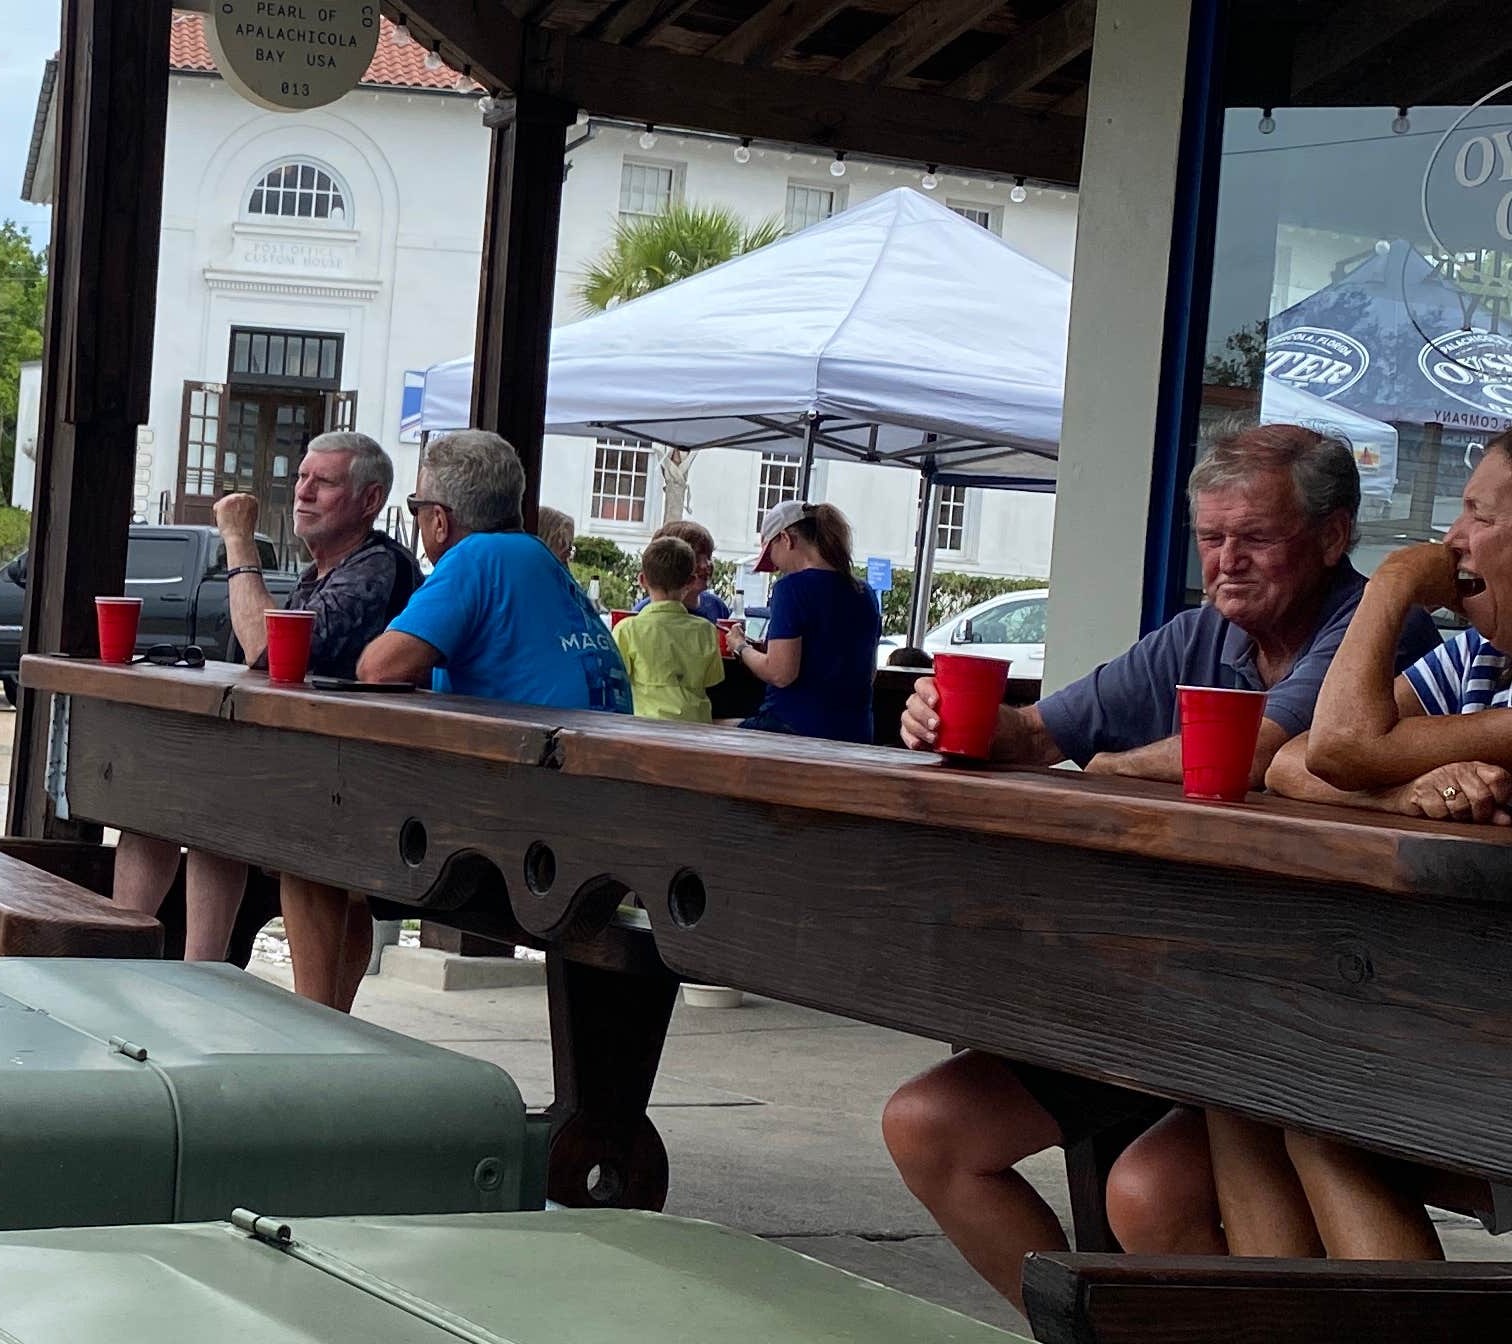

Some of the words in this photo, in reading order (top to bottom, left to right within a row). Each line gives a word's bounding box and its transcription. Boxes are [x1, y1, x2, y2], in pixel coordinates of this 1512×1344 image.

[256, 1, 307, 20] PEARL
[318, 8, 337, 22] OF
[361, 5, 373, 28] CO
[235, 23, 357, 47] APALACHICOLA
[255, 48, 286, 63] BAY
[306, 54, 337, 68] USA
